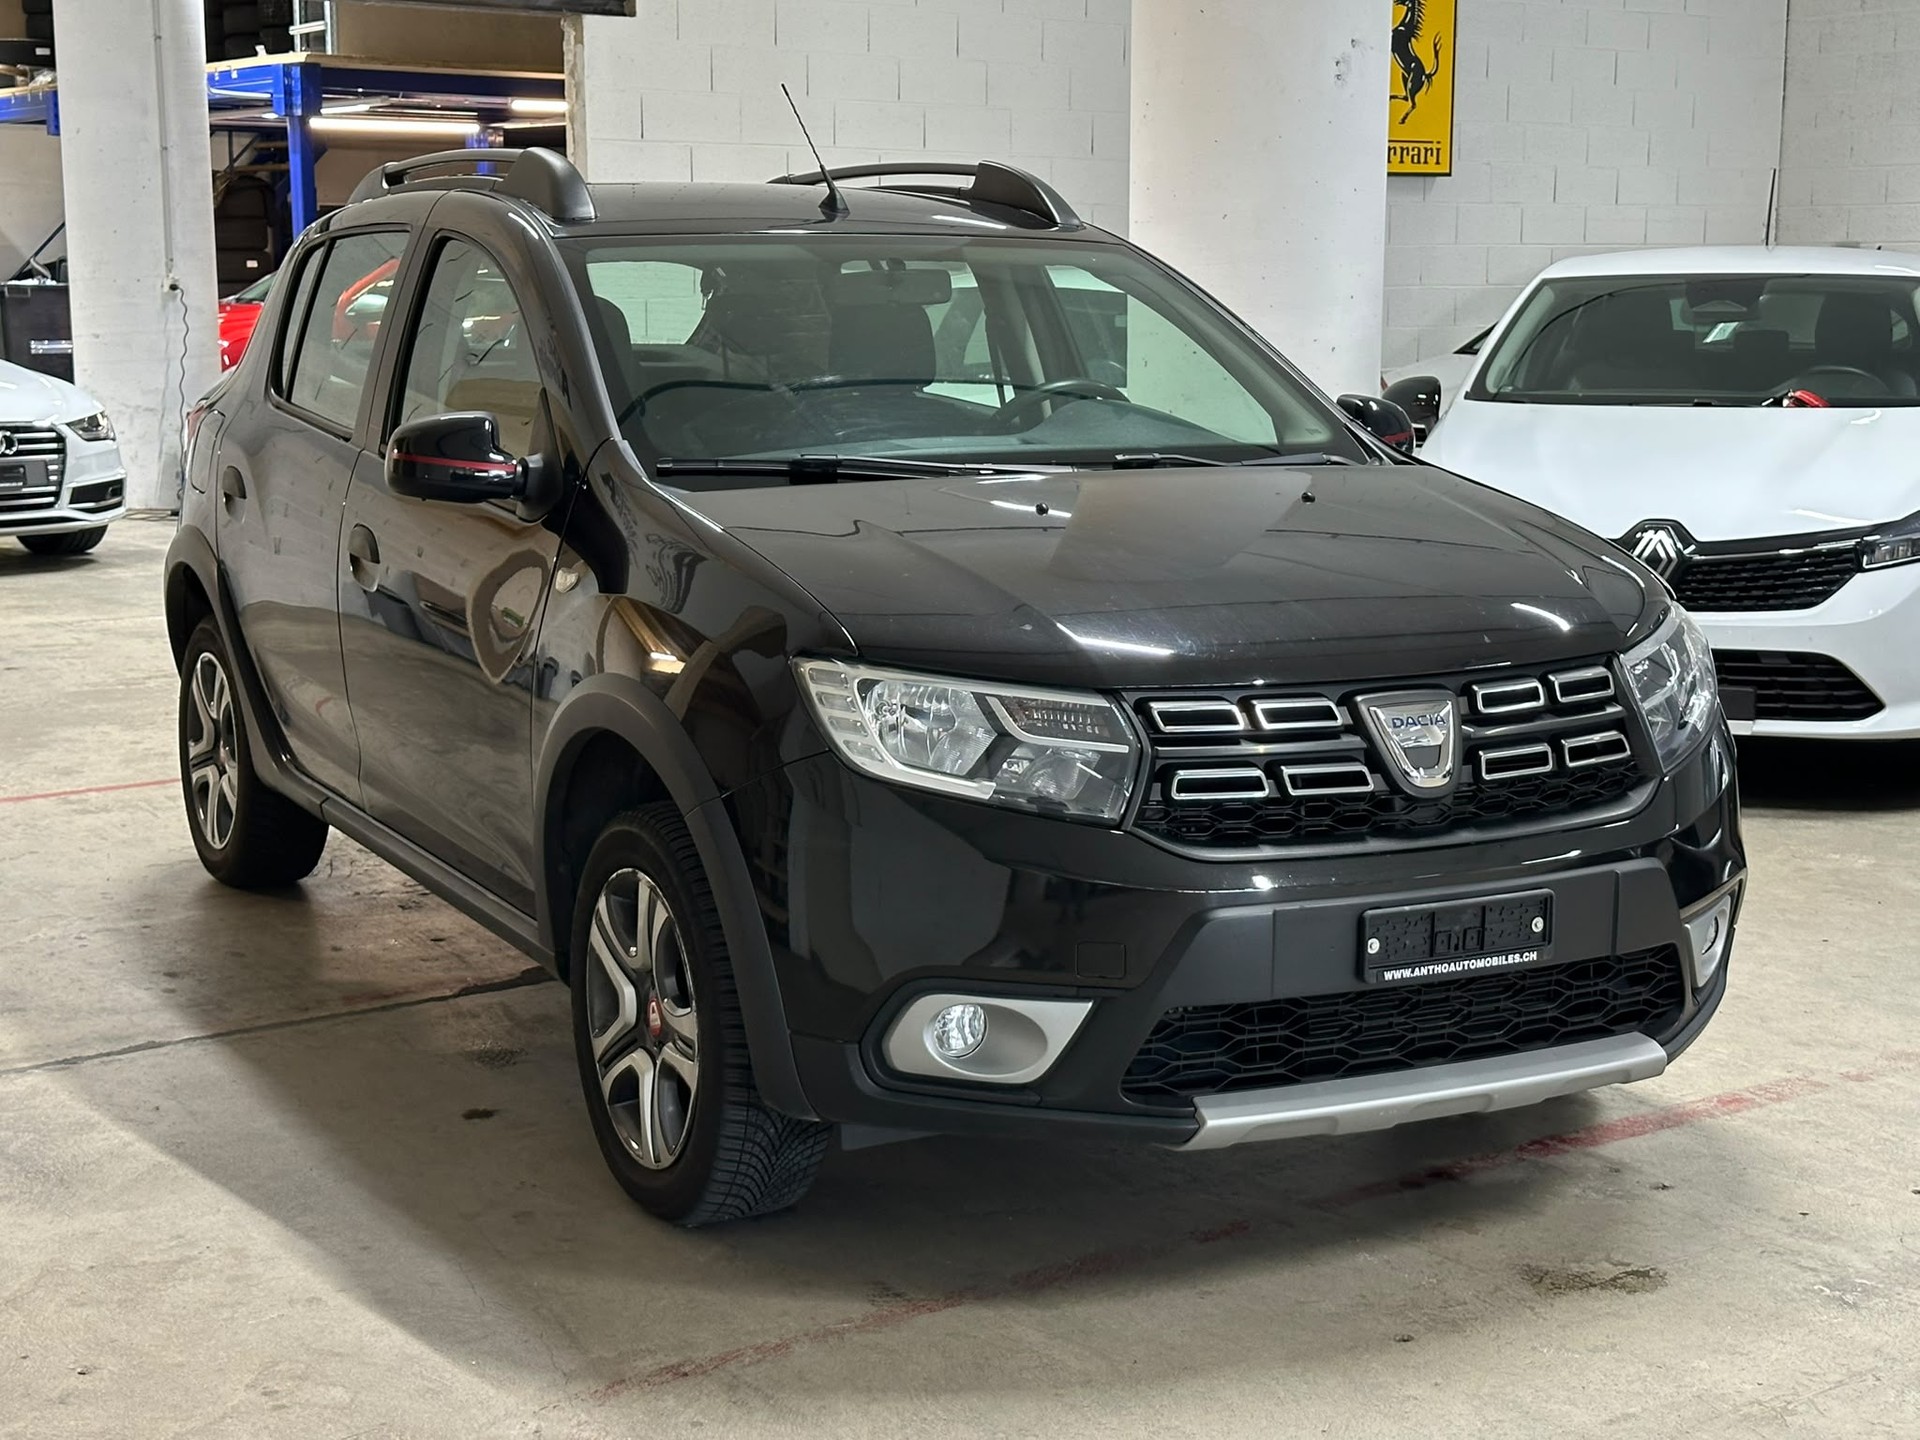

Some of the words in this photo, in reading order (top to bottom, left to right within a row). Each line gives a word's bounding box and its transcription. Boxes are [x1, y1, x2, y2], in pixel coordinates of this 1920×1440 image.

[1388, 140, 1441, 165] rrari
[1392, 714, 1446, 729] DACIA
[1384, 951, 1538, 981] WWW.ANTHOAUTOMOBILES.CH
